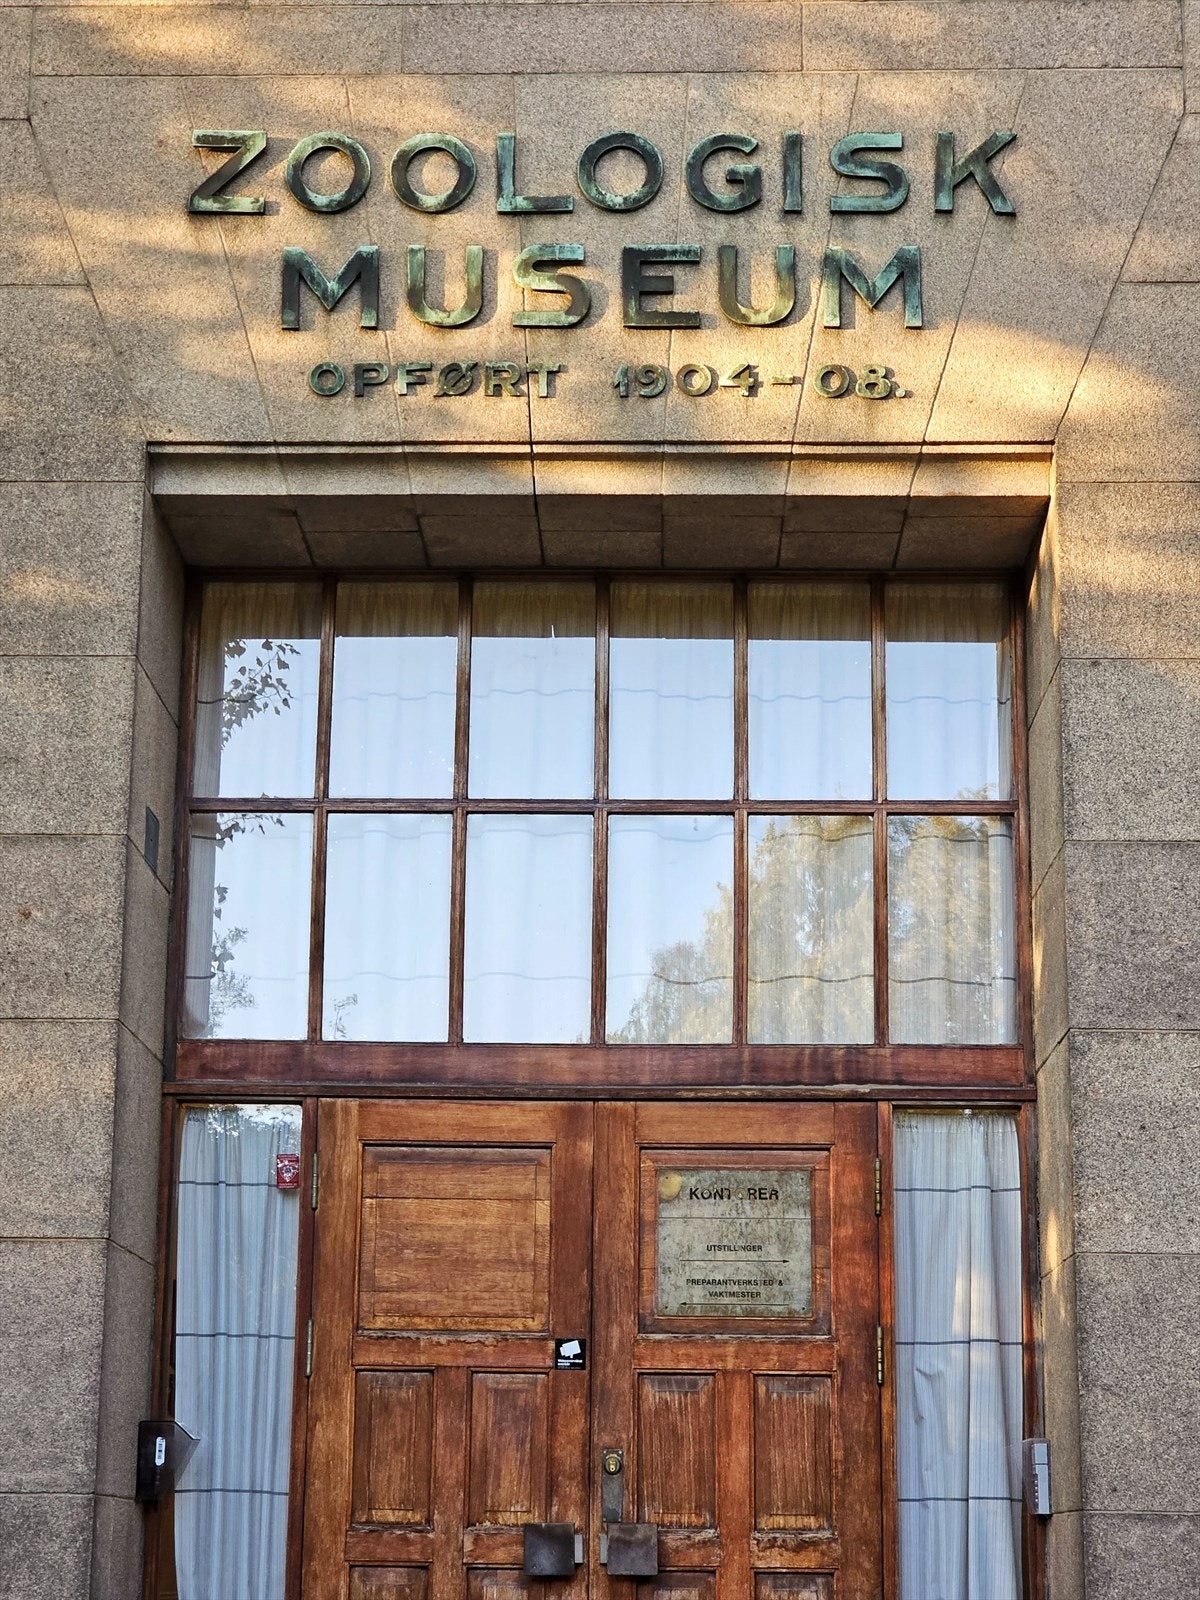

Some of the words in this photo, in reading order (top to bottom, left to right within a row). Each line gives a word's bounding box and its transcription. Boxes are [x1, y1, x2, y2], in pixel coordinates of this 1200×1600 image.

[188, 129, 1017, 216] ZOOLOGISK
[281, 243, 923, 330] MUSEUM
[309, 360, 562, 399] OPFØRT
[690, 1188, 779, 1200] KONTRER
[706, 1244, 763, 1252] UTSTILLNGER
